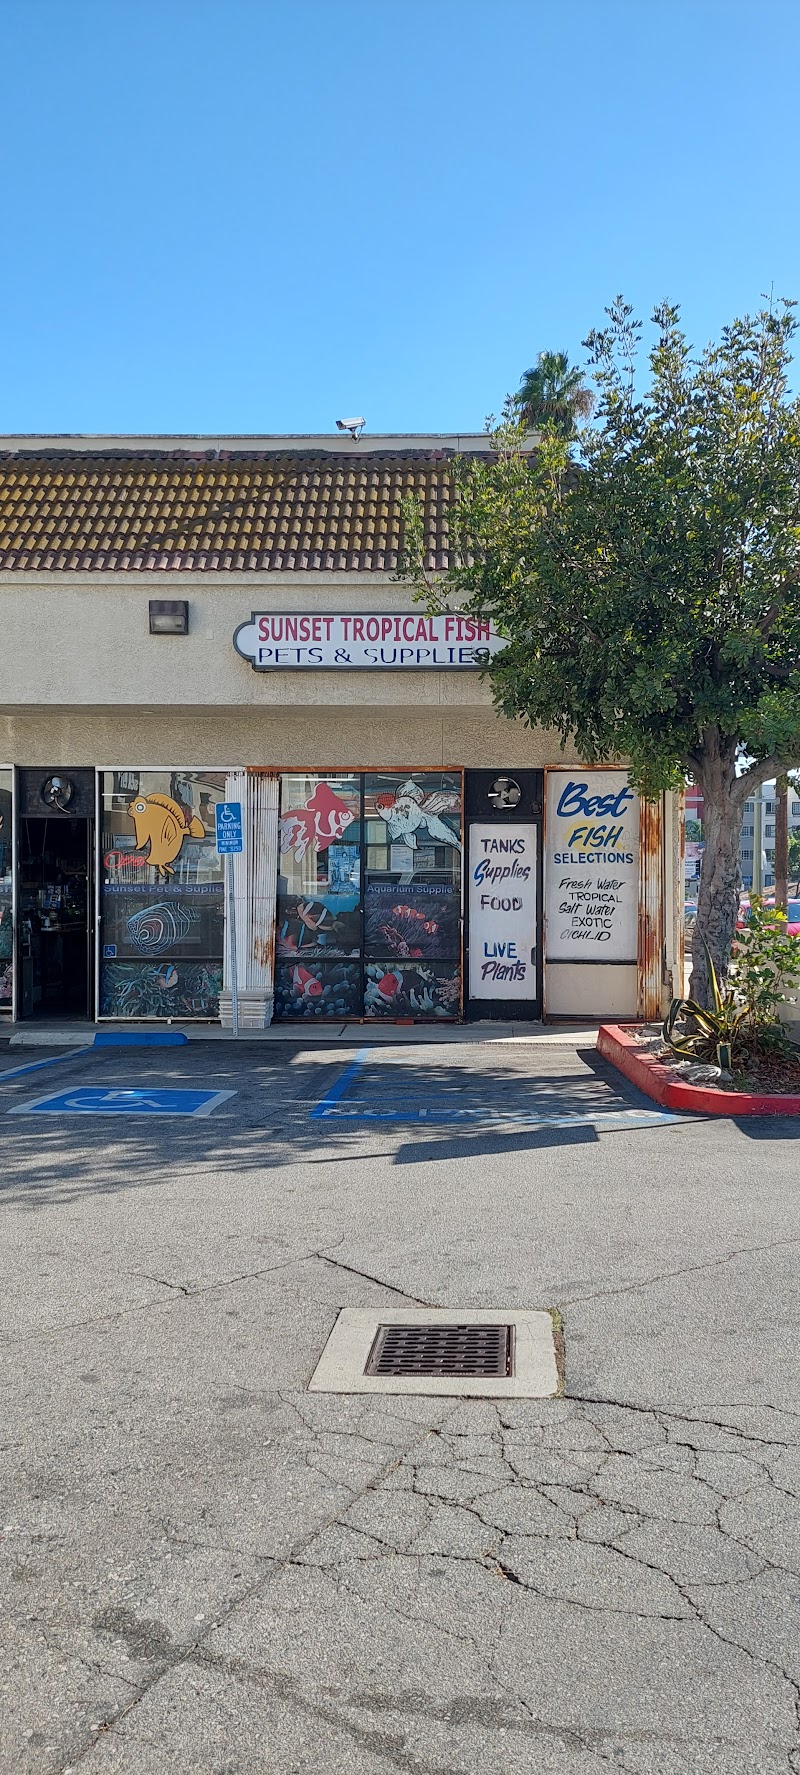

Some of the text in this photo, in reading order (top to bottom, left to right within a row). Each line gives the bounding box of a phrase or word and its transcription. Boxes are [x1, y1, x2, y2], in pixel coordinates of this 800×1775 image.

[258, 617, 490, 642] SUNSET TROPICAL FISH
[258, 647, 490, 663] PETS & SUPPLIES
[556, 781, 634, 818] Best
[218, 822, 241, 830] PARKING
[568, 825, 624, 848] FISH
[481, 839, 525, 854] TANKS
[104, 851, 149, 869] Ope
[553, 852, 634, 864] SELECTIONS
[473, 858, 531, 887] Supplies
[104, 884, 147, 893] Sunset
[149, 884, 169, 893] Pet
[173, 884, 182, 893] &
[367, 885, 414, 894] Aquarium
[558, 877, 626, 891] Fresh Water
[480, 894, 523, 911] FOOD
[569, 892, 623, 903] TROPICAL
[558, 901, 616, 917] Salt Water
[572, 917, 613, 929] EXOTIC
[484, 942, 517, 958] LIVE
[481, 959, 526, 982] Plants
